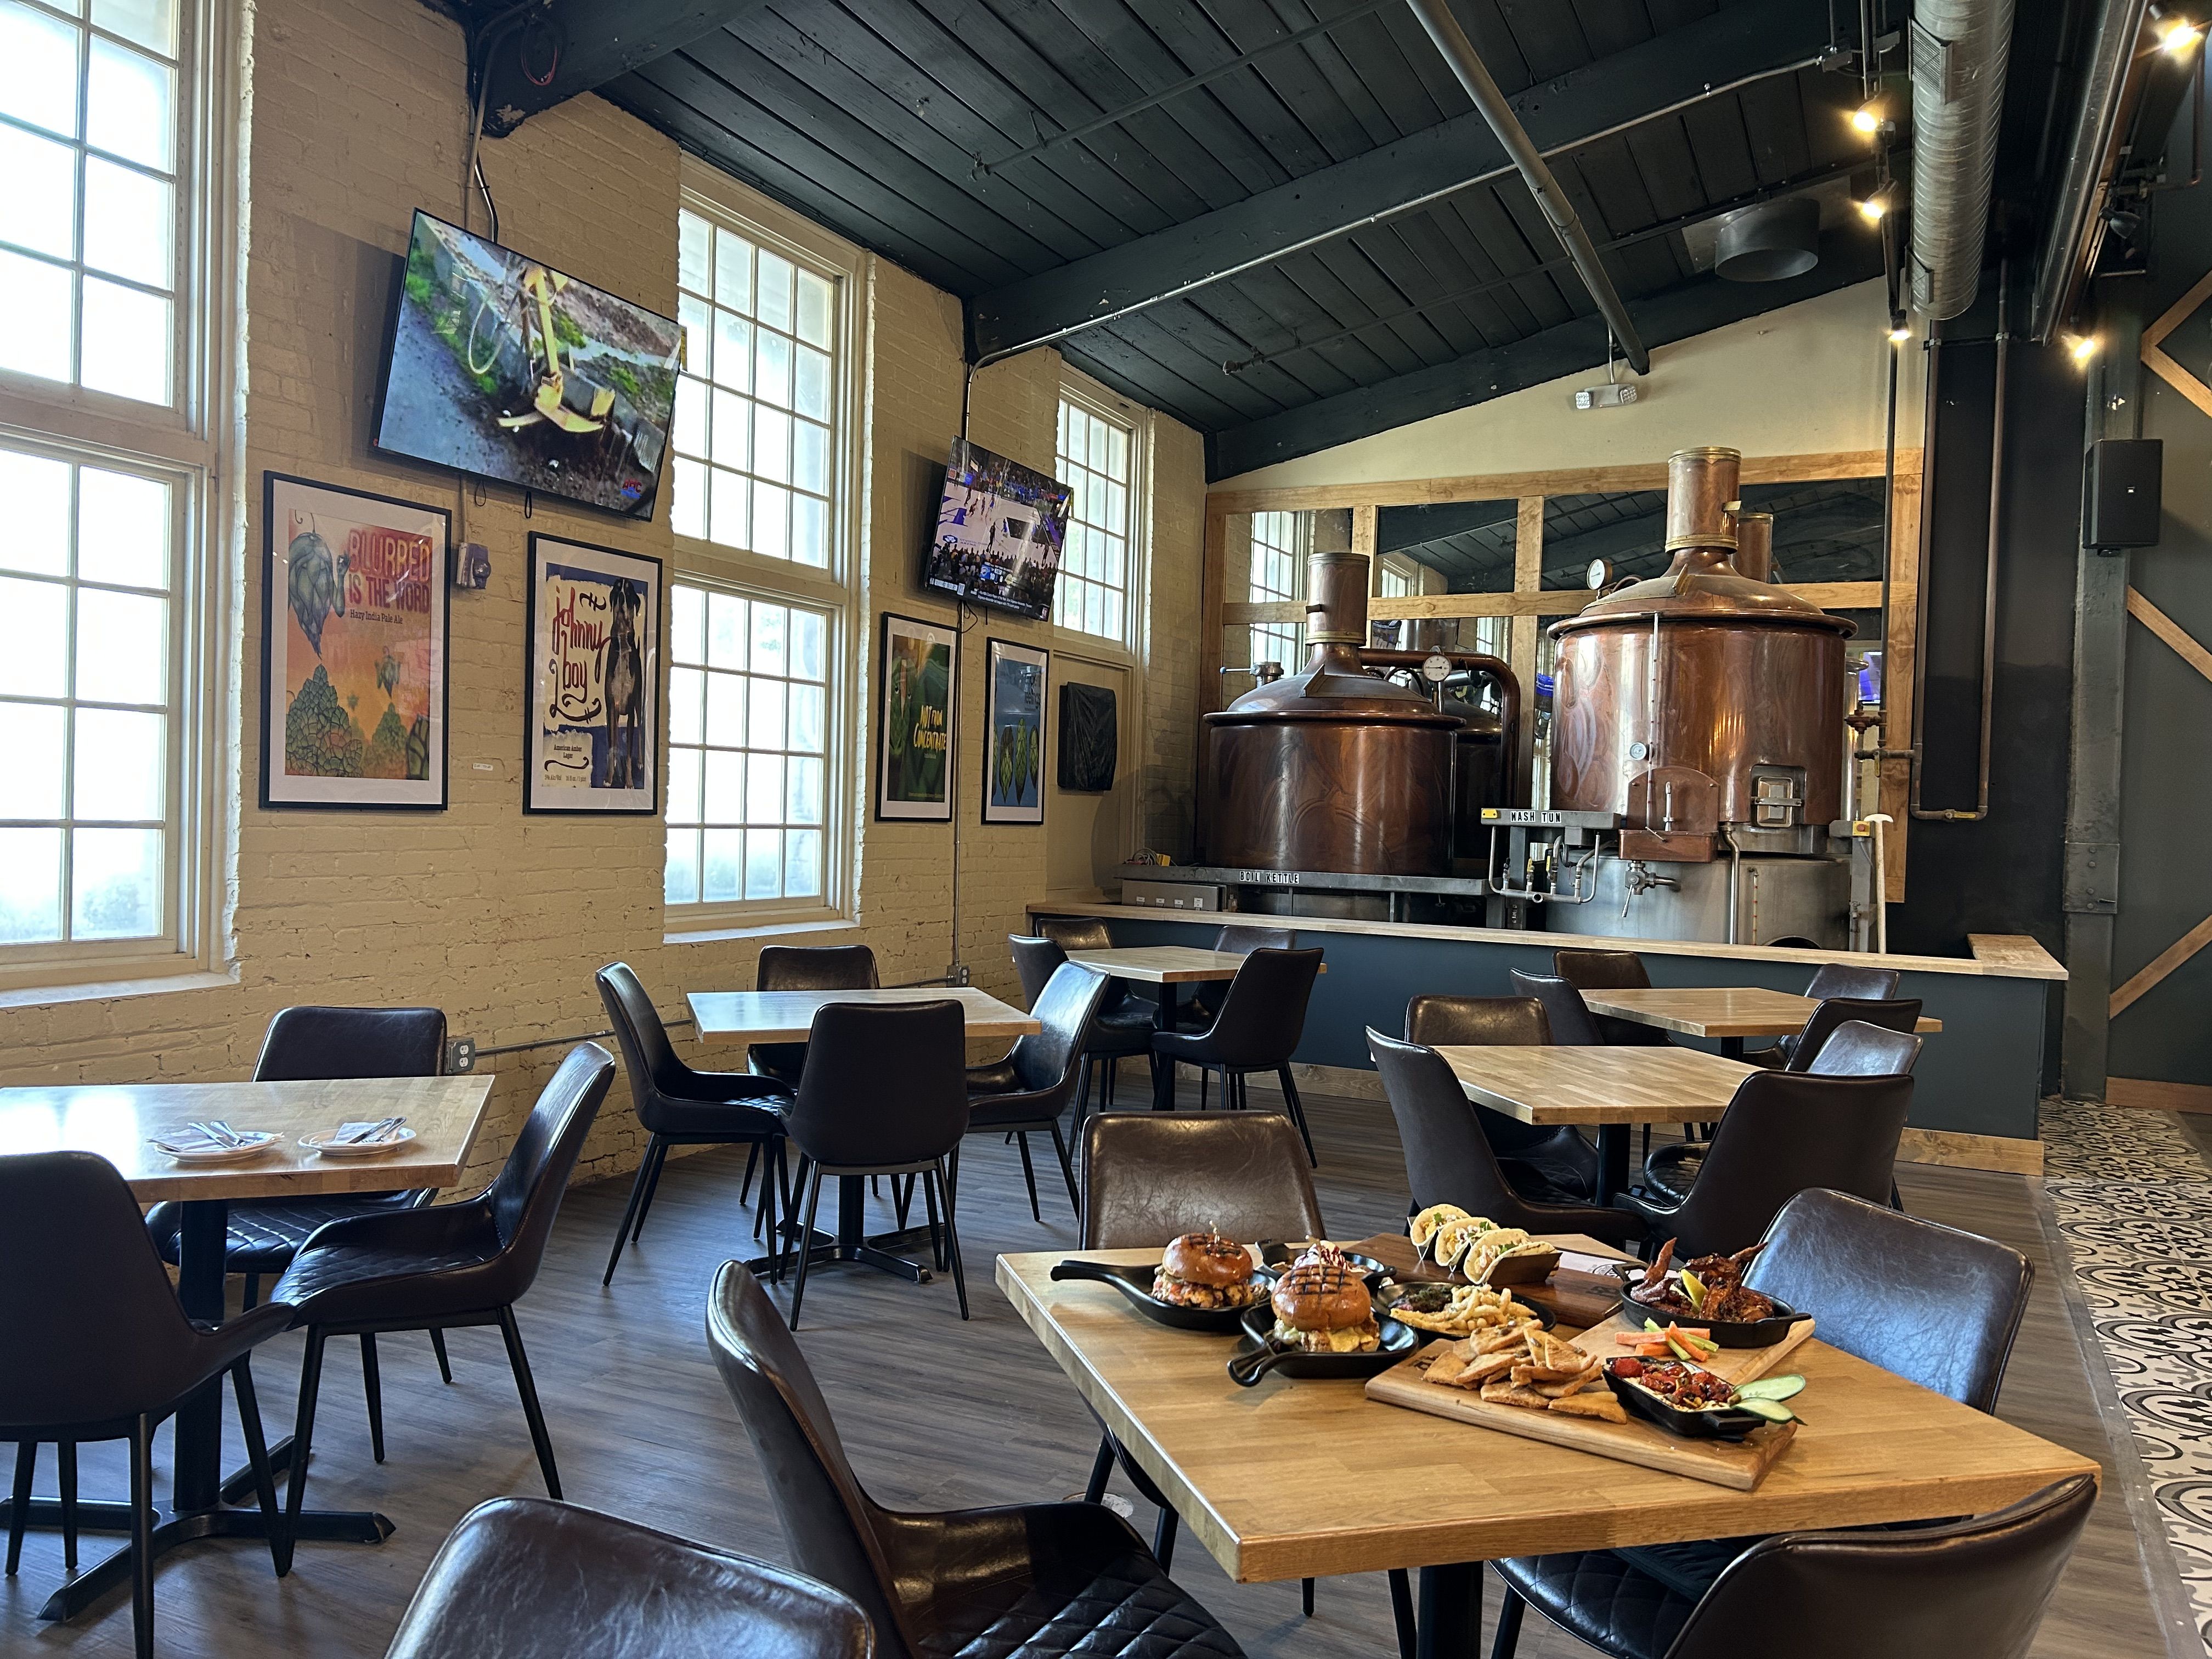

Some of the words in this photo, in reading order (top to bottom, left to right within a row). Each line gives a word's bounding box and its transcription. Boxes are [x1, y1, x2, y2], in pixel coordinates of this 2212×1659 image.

[349, 528, 430, 583] BLURRED
[349, 573, 362, 605] IS
[365, 576, 391, 608] THE
[394, 582, 430, 614] WORD
[350, 609, 365, 622] Hazy
[366, 611, 381, 622] India
[381, 613, 393, 623] Pale
[393, 614, 403, 624] Ale
[552, 585, 612, 684] johnny
[561, 630, 588, 708] boy
[1511, 811, 1534, 821] MASH
[1542, 812, 1560, 822] TUN
[1240, 871, 1259, 882] BOIL
[1267, 873, 1298, 883] KETTLE
